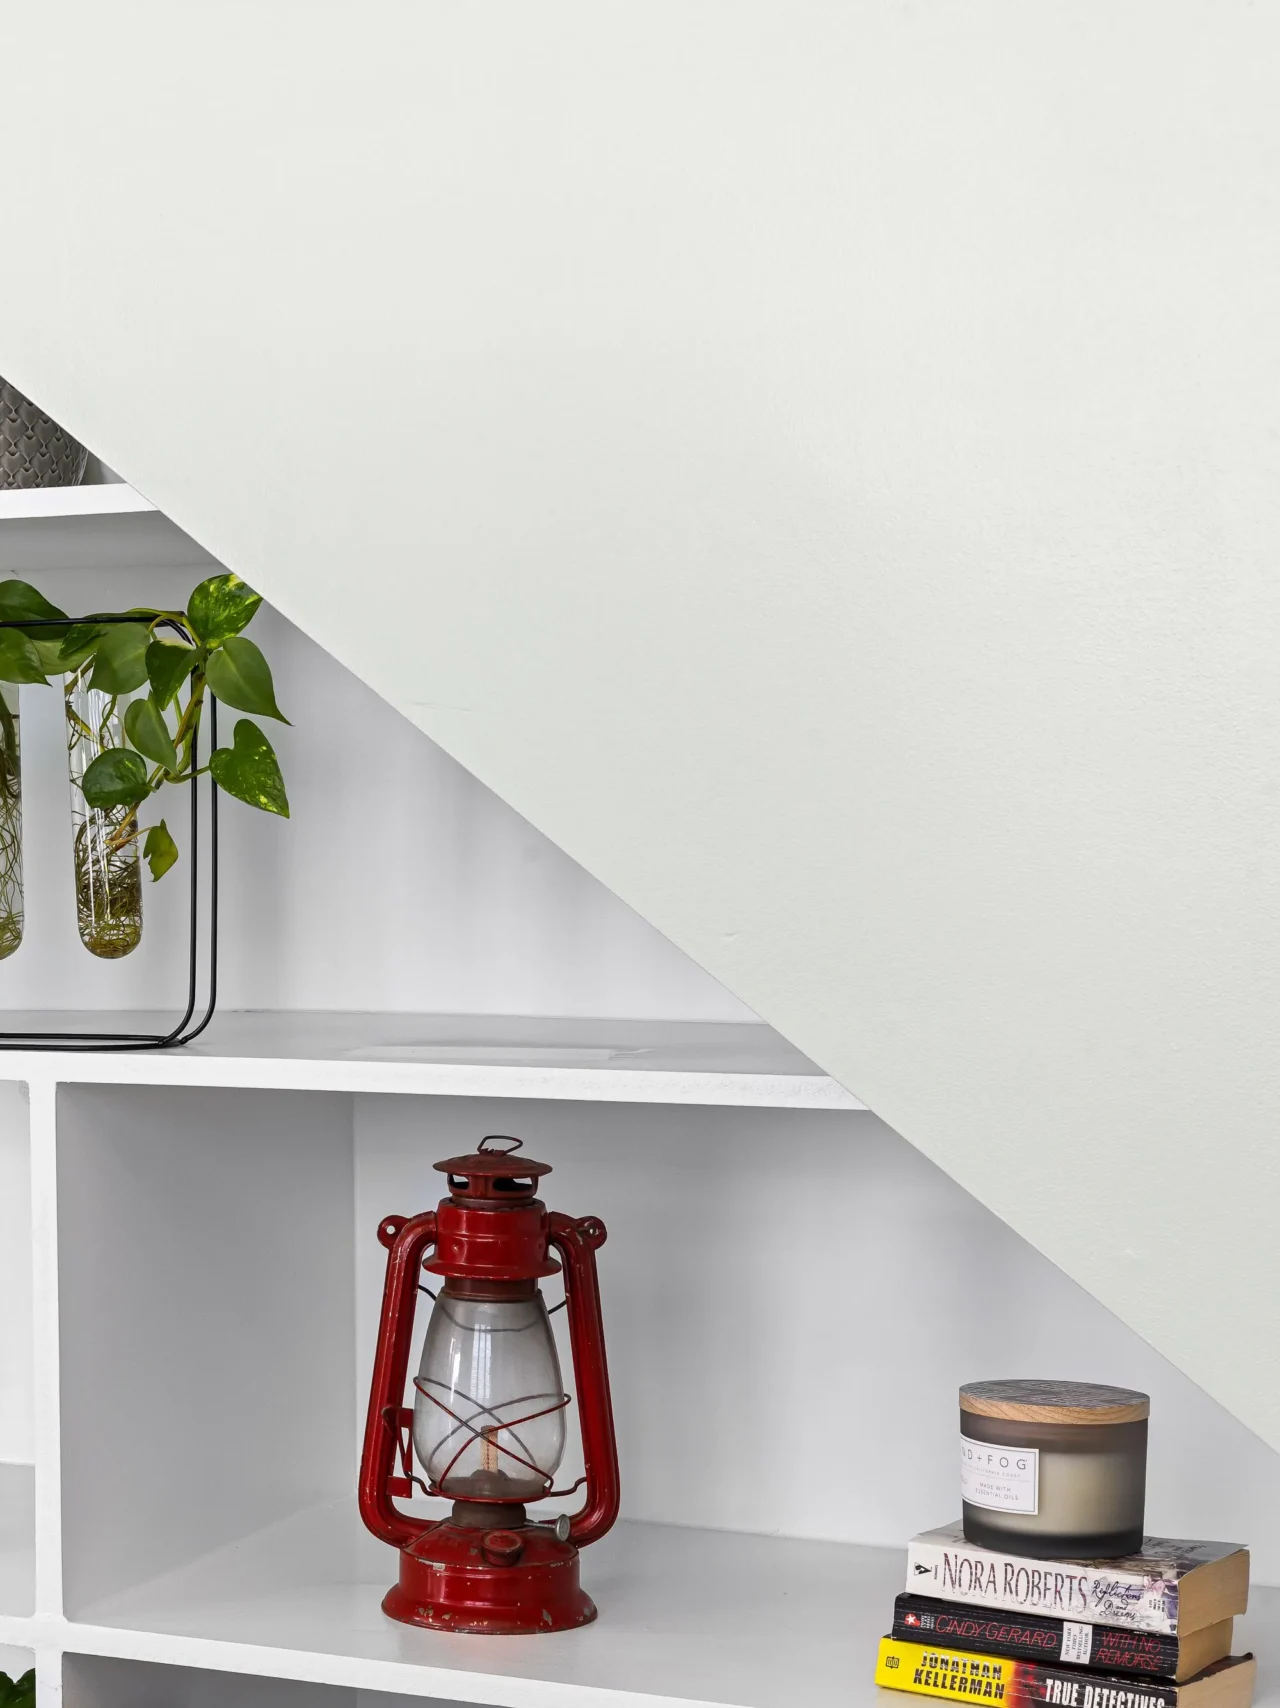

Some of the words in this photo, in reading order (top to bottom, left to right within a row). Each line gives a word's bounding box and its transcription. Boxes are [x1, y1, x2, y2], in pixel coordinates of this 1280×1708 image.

[975, 1488, 1002, 1498] ESSENTIAL
[980, 1482, 994, 1490] MADE
[942, 1552, 998, 1599] NORA
[1003, 1562, 1088, 1613] ROBERTS
[1092, 1580, 1143, 1607] Reflections
[935, 1615, 986, 1637] CINDY
[986, 1622, 1057, 1648] GERARD
[1103, 1631, 1136, 1649] WITH
[1139, 1636, 1161, 1653] NO
[921, 1651, 1003, 1680] JONATHAN
[1096, 1648, 1162, 1670] REMORSE
[913, 1668, 1005, 1699] KELLERMAN
[1045, 1678, 1079, 1707] TRUE
